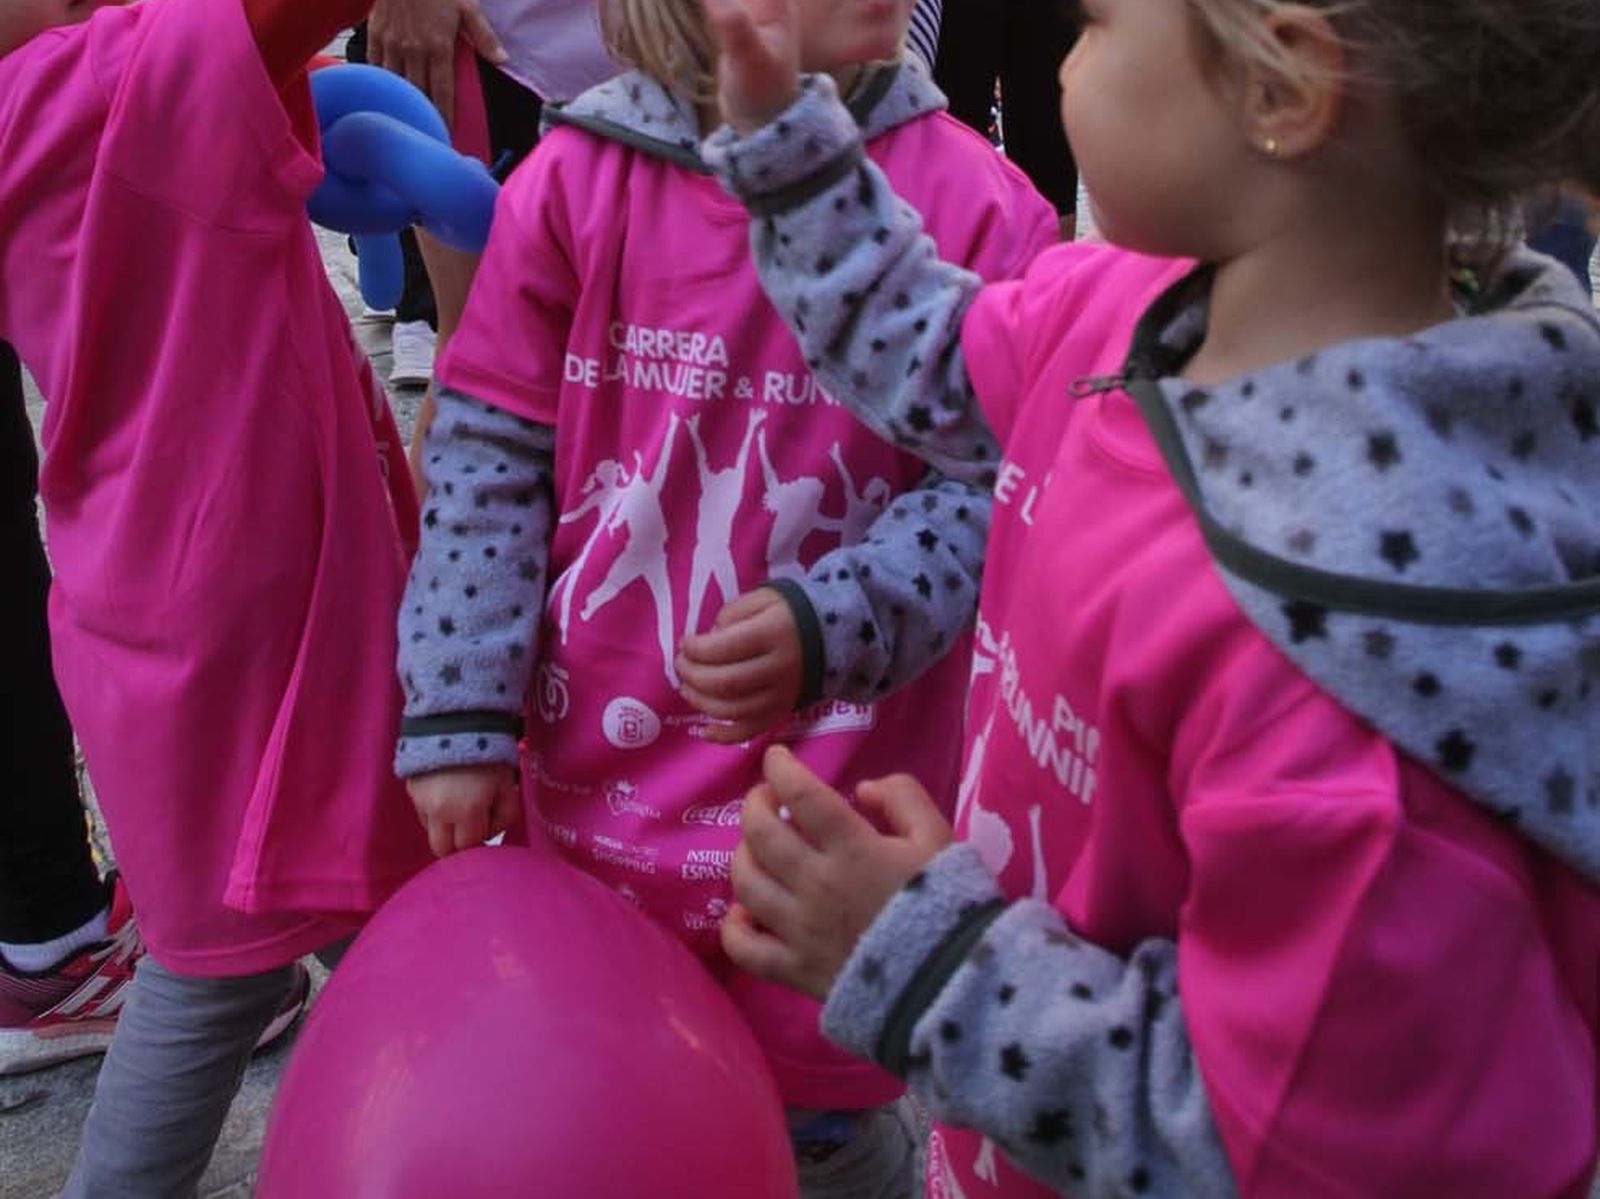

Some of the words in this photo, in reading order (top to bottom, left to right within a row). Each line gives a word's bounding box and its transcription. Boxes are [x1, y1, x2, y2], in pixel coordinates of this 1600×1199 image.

[609, 323, 728, 367] CARRERA
[565, 353, 598, 388] DE
[733, 377, 754, 398] &
[763, 371, 841, 406] RUN
